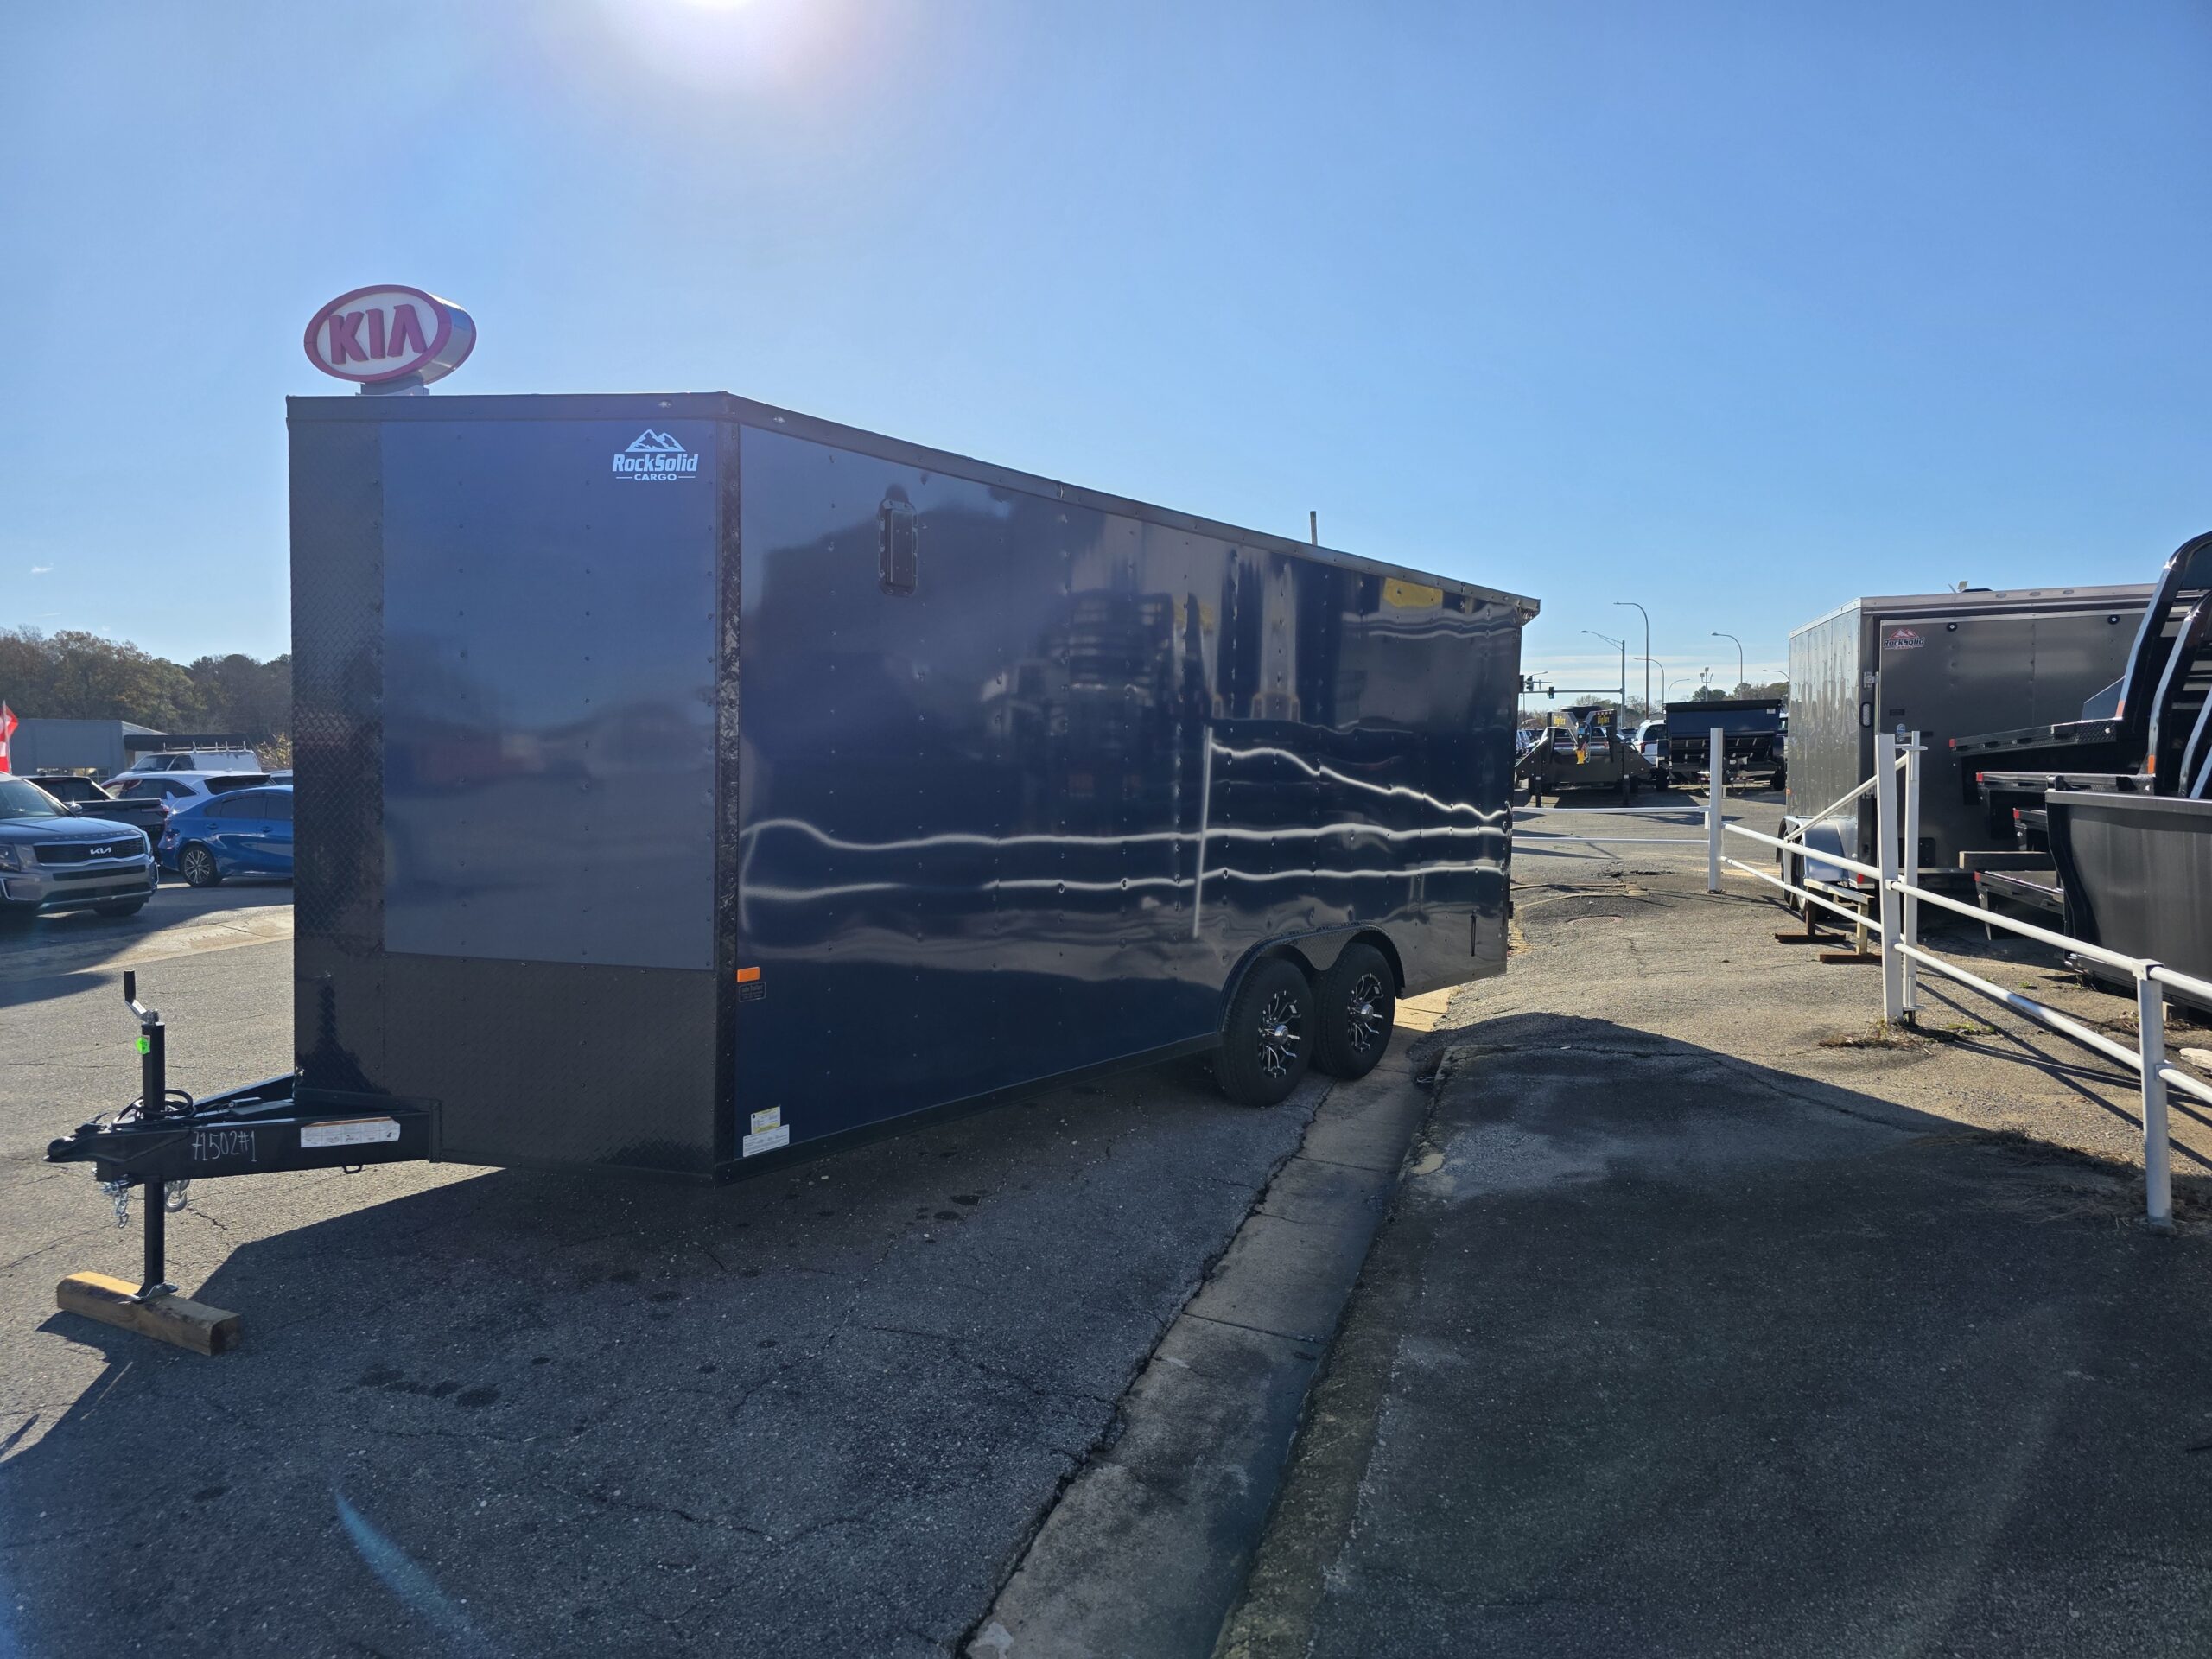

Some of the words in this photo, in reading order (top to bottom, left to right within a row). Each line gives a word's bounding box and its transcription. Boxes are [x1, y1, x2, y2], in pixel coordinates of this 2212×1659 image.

[327, 304, 428, 365] KIA
[612, 454, 699, 472] RockSolid
[633, 473, 677, 481] CARGO
